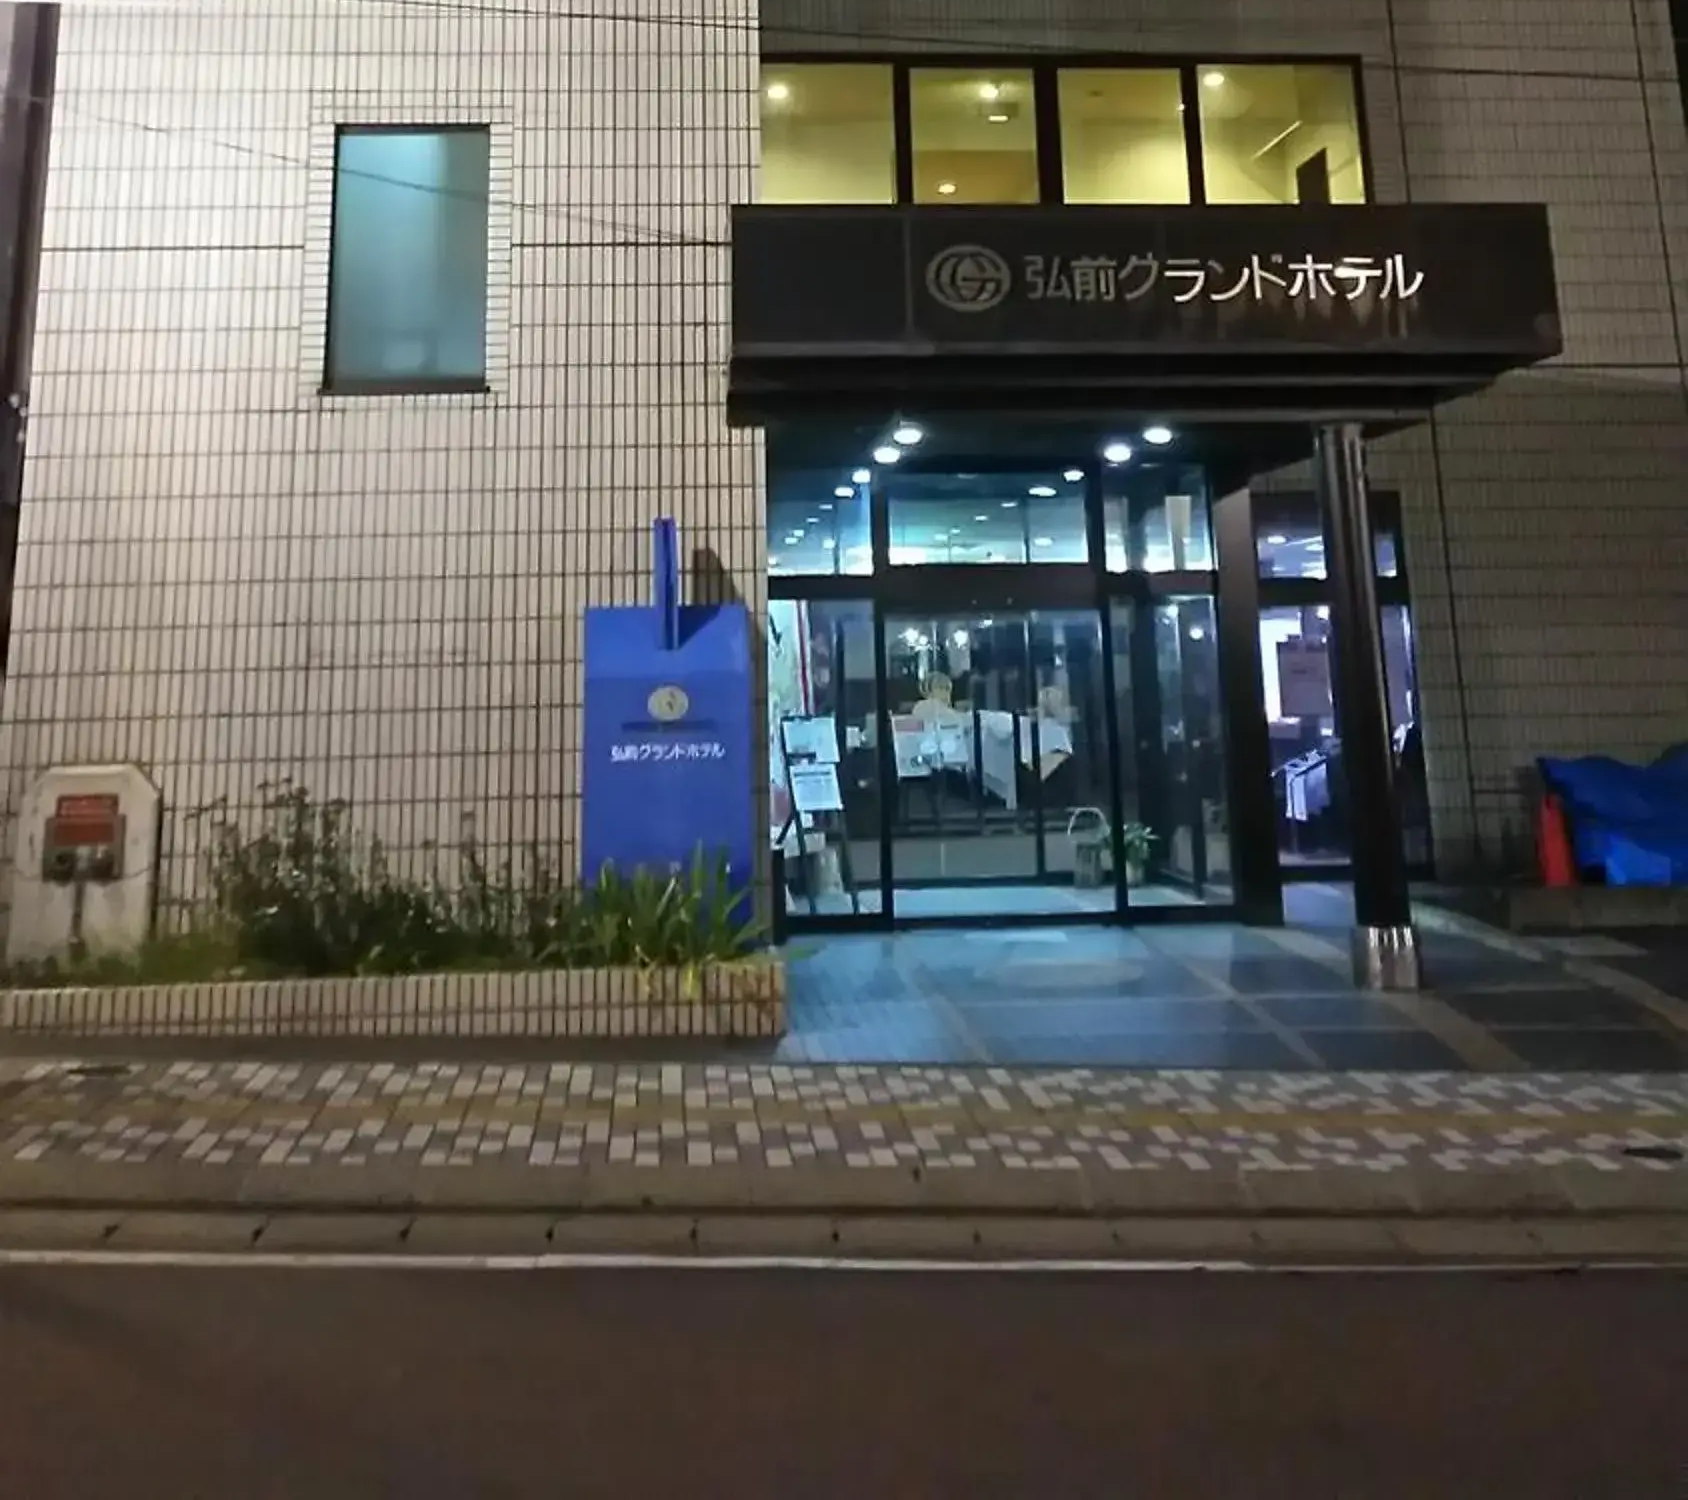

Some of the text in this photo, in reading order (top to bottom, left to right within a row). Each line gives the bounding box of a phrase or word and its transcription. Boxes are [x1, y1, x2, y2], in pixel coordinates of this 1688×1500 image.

[1022, 252, 1425, 302] 弘前グランドホテル
